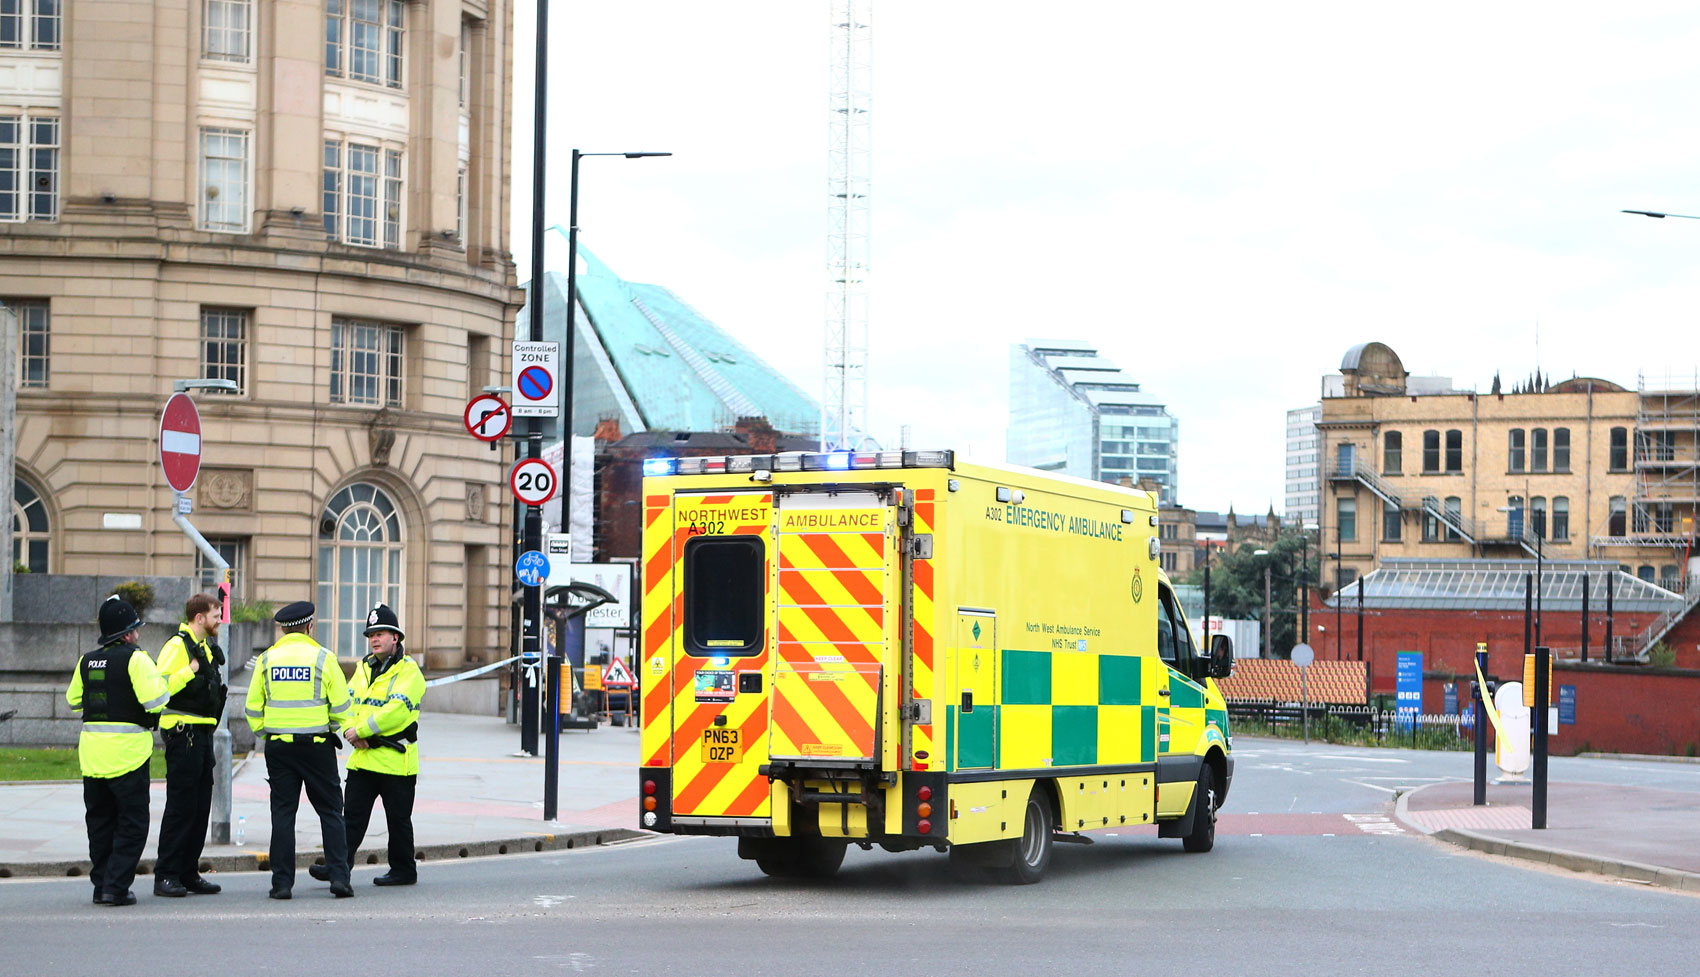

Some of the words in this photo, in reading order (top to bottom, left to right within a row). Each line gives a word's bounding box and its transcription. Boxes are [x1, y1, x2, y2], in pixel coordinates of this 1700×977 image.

[514, 344, 557, 352] Controlled
[521, 354, 550, 362] ZONE
[518, 472, 550, 492] 20
[678, 508, 767, 522] NORTHWEST
[785, 514, 879, 527] AMBULANCE
[985, 506, 1002, 521] A302
[1006, 505, 1065, 532] EMERGENCY
[1068, 515, 1122, 542] AMBULANCE
[687, 521, 725, 535] A302
[1026, 621, 1040, 633] North
[1042, 623, 1054, 634] West
[1056, 624, 1082, 635] Ambulance
[1083, 626, 1100, 637] Service
[1051, 638, 1062, 649] NHS
[1064, 639, 1077, 649] Trust
[88, 660, 107, 668] POLICE
[272, 667, 310, 680] POLICE
[704, 730, 738, 744] PN63
[709, 747, 734, 760] OZP
